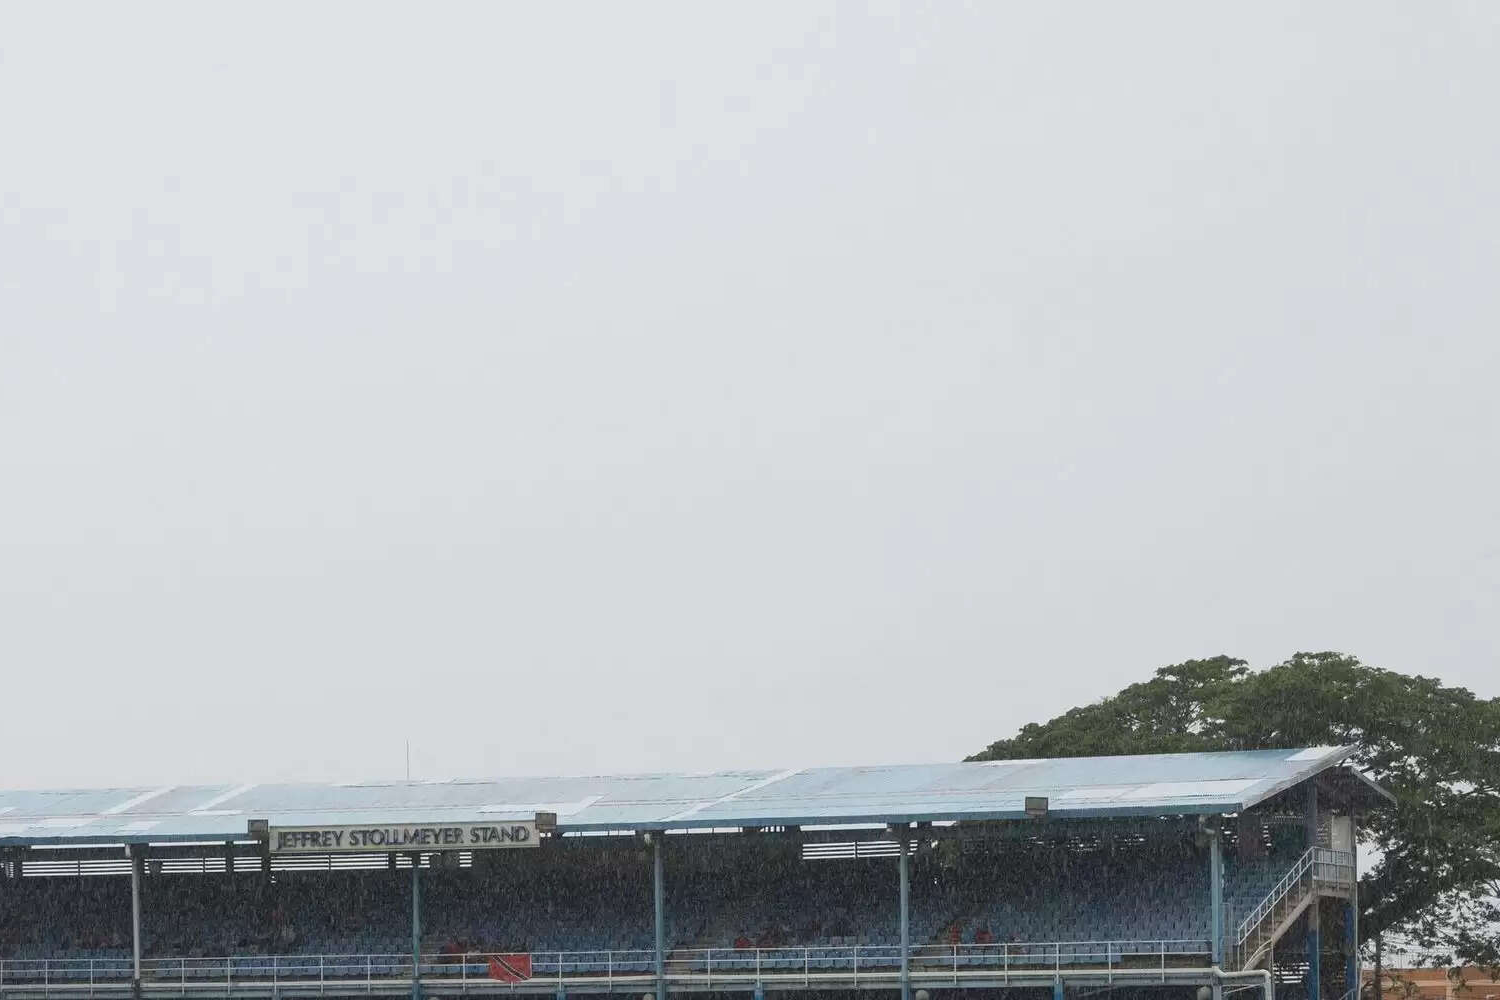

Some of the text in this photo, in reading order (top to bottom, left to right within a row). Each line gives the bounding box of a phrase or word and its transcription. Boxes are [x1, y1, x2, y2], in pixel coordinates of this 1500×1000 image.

[276, 823, 531, 851] JEFFREY STOLLMEYER STAND
